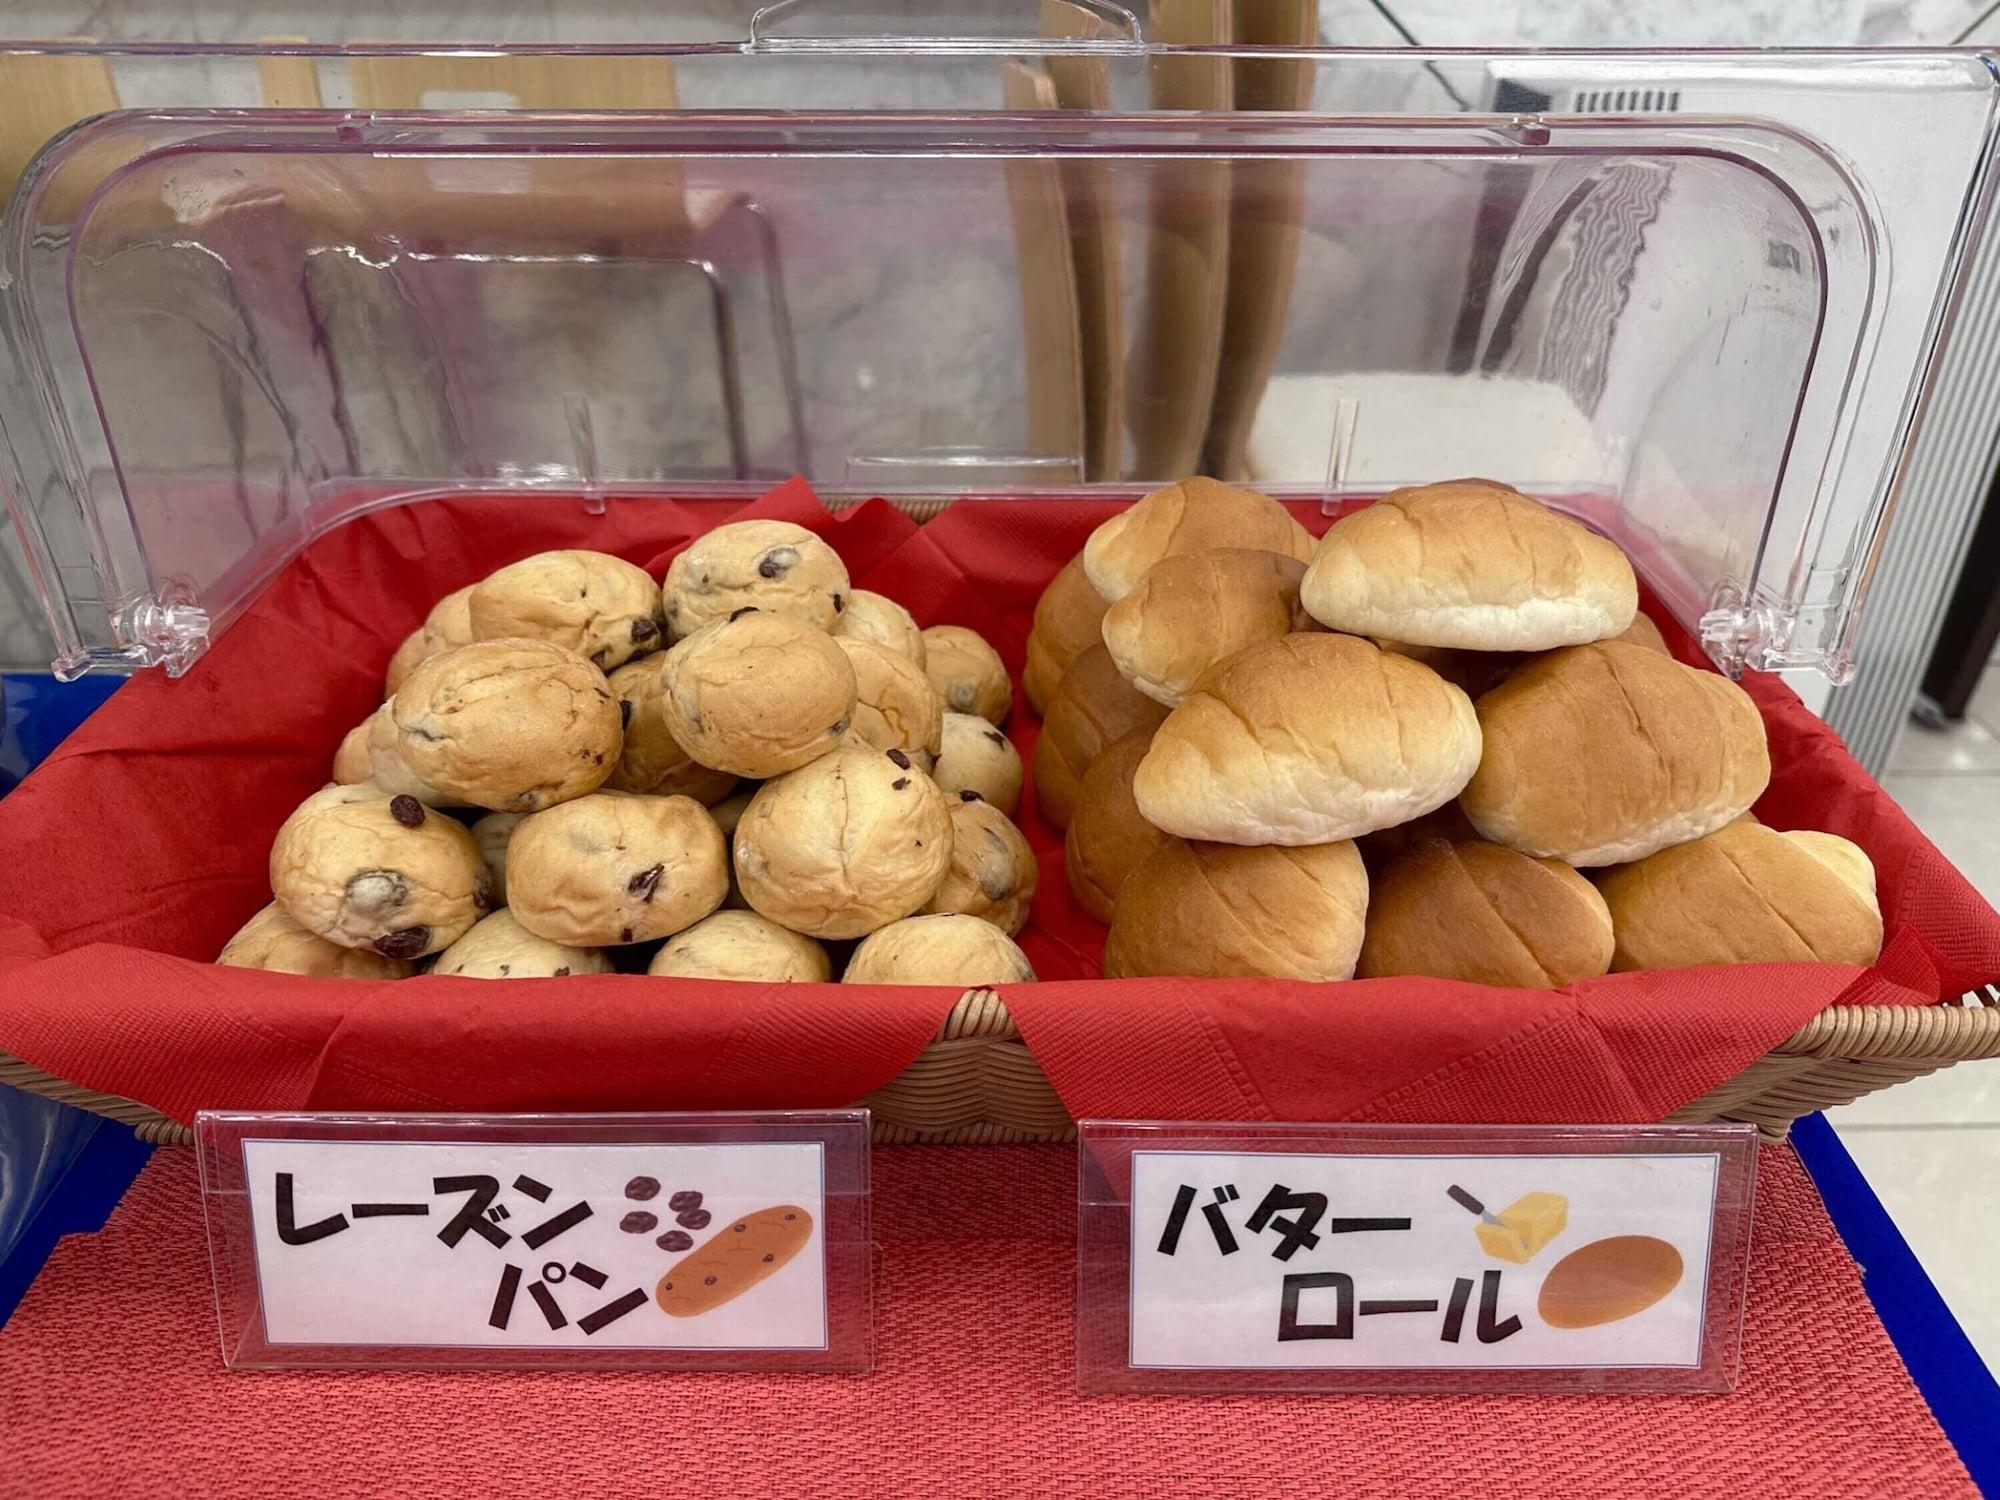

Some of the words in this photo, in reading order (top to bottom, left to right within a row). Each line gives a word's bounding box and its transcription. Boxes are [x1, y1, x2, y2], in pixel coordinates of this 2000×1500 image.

[274, 1171, 595, 1252] レーズン
[1155, 1183, 1413, 1263] バター
[487, 1260, 650, 1337] パン
[1276, 1269, 1524, 1345] ロール
